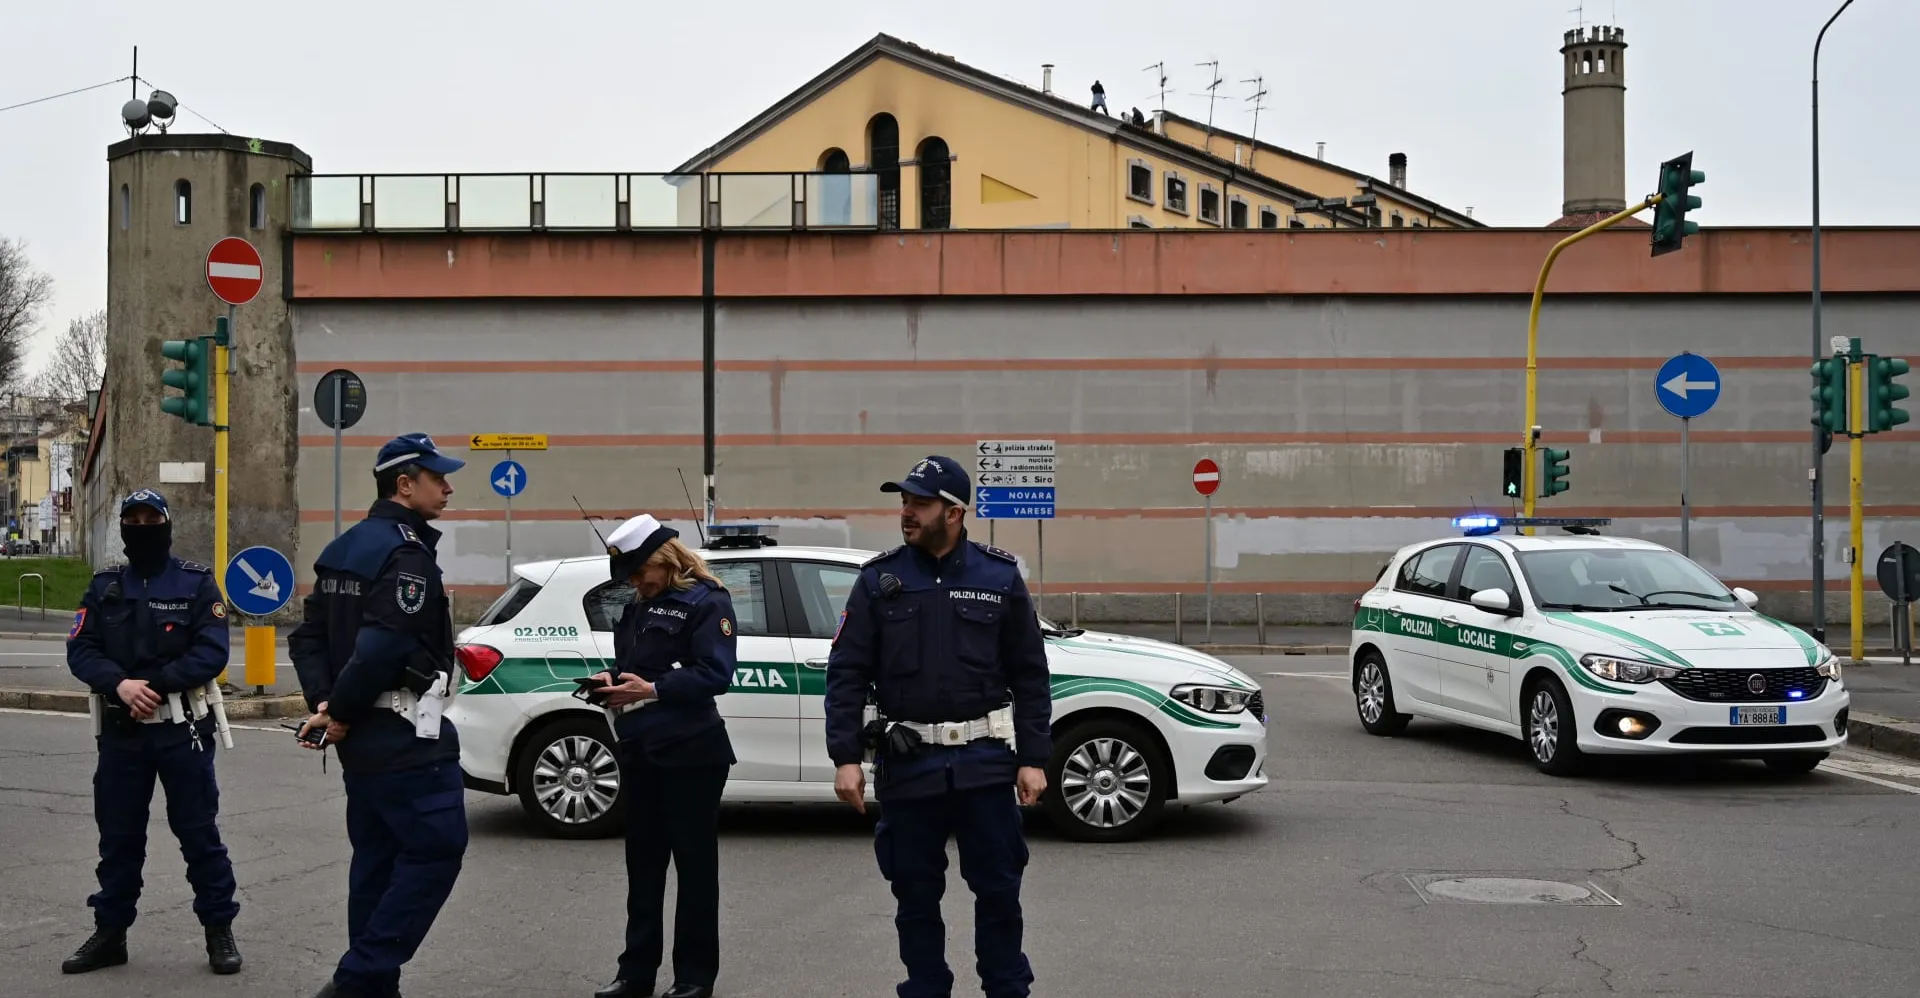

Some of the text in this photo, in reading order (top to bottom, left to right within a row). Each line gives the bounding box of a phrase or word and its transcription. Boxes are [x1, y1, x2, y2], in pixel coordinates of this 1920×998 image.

[1005, 444, 1024, 452] polizia
[1008, 492, 1052, 500] NOVARA
[950, 590, 1002, 604] POLIZIA LOCALE
[514, 626, 578, 636] 02.0208
[1400, 618, 1496, 650] POLIZIA LOCALE
